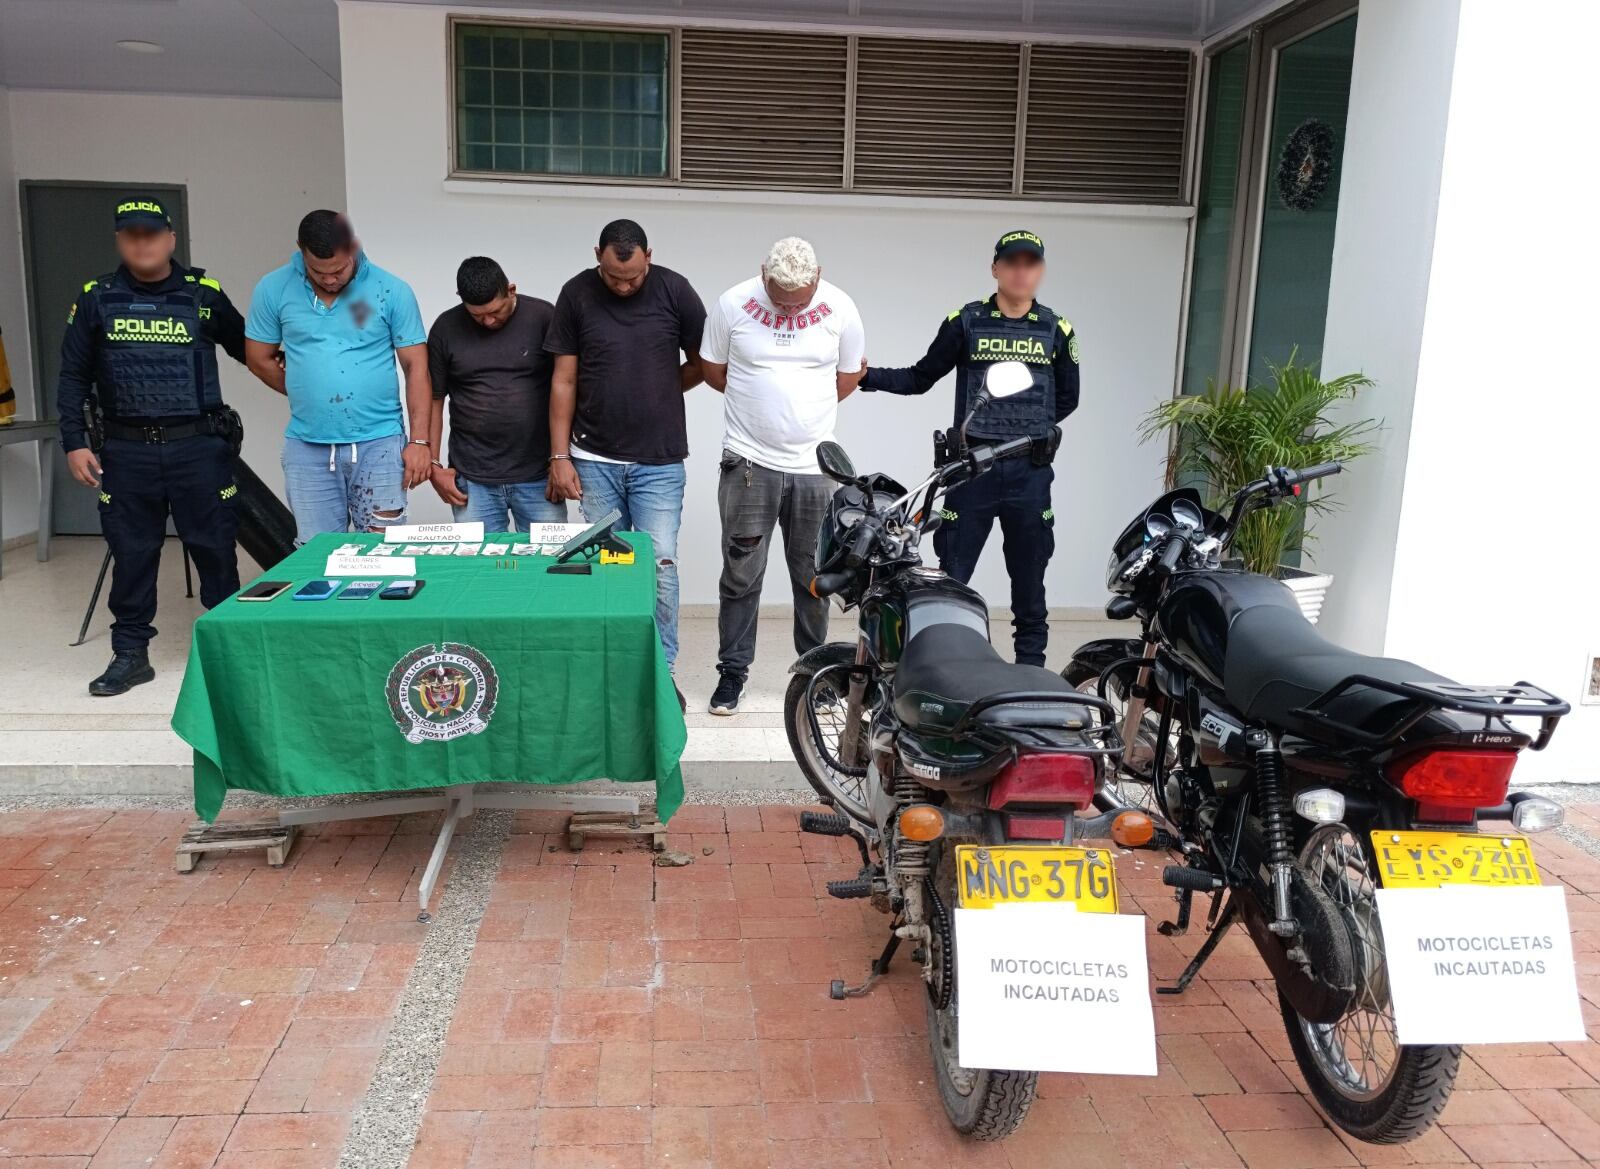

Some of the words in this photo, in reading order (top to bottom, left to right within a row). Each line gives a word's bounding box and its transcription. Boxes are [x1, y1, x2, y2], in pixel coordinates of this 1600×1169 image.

[117, 202, 162, 214] POLICÍA
[741, 297, 833, 331] HILFIGER
[114, 317, 188, 335] POLICÍA
[978, 337, 1045, 355] POLICÍA
[456, 657, 485, 692] COLOMBIA
[447, 701, 481, 728] NACIONAL
[418, 729, 438, 738] DIOS
[447, 722, 475, 737] PATRIA
[1485, 735, 1512, 743] Hero
[1379, 843, 1454, 881] EYS
[1462, 846, 1537, 885] 23H
[965, 859, 1031, 899] MNG
[1042, 860, 1110, 899] 37G
[1416, 935, 1554, 952] MOTOCICLETAS
[990, 958, 1129, 978] MOTOCICLETAS
[1433, 960, 1547, 977] INCAUTADAS
[1004, 984, 1120, 1003] INCAUTADAS
